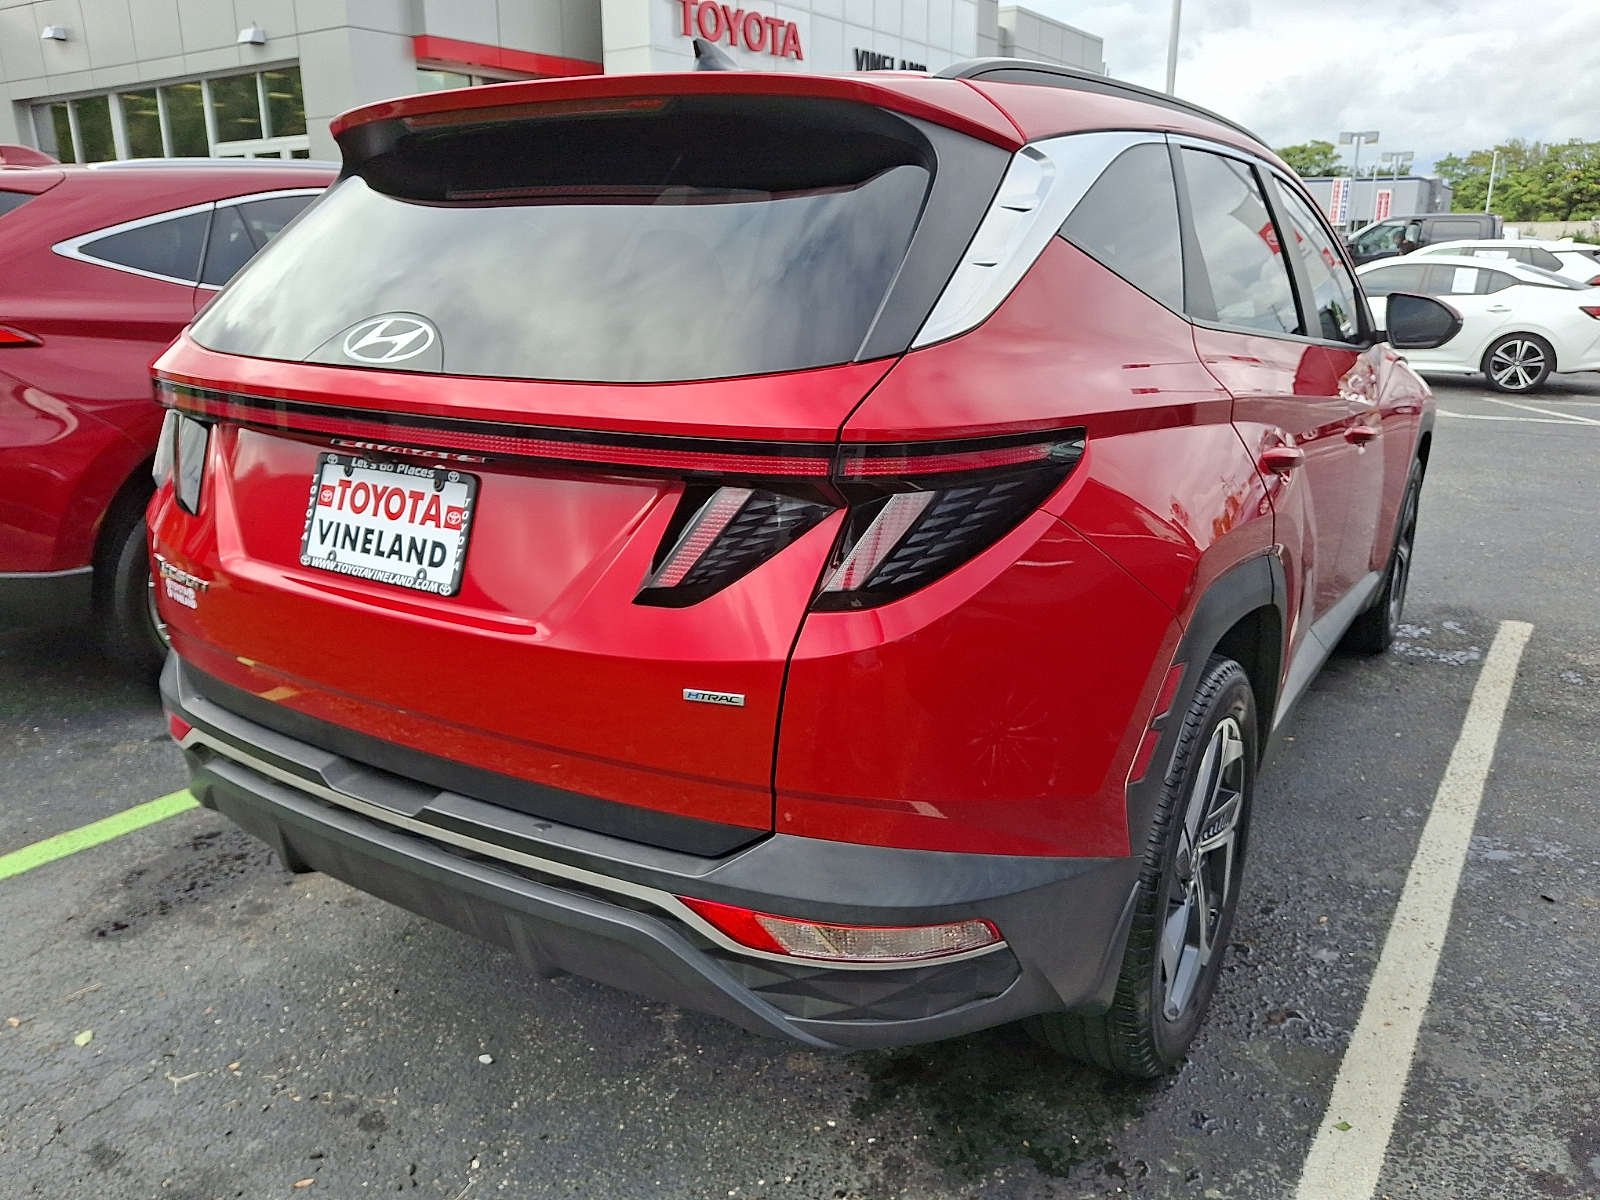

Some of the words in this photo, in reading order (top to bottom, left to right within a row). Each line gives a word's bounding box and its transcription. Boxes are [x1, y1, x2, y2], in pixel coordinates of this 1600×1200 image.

[676, 0, 804, 61] TOYOTA
[855, 48, 927, 72] VINEL
[396, 463, 436, 479] Places
[301, 473, 319, 541] TOYOTA
[336, 479, 442, 529] TOYOTA
[318, 518, 447, 568] VINELAND
[453, 497, 471, 572] TOYOTA
[311, 557, 439, 593] WWW.TOYOTAVINELAND.COM
[687, 691, 740, 704] HTRAC
